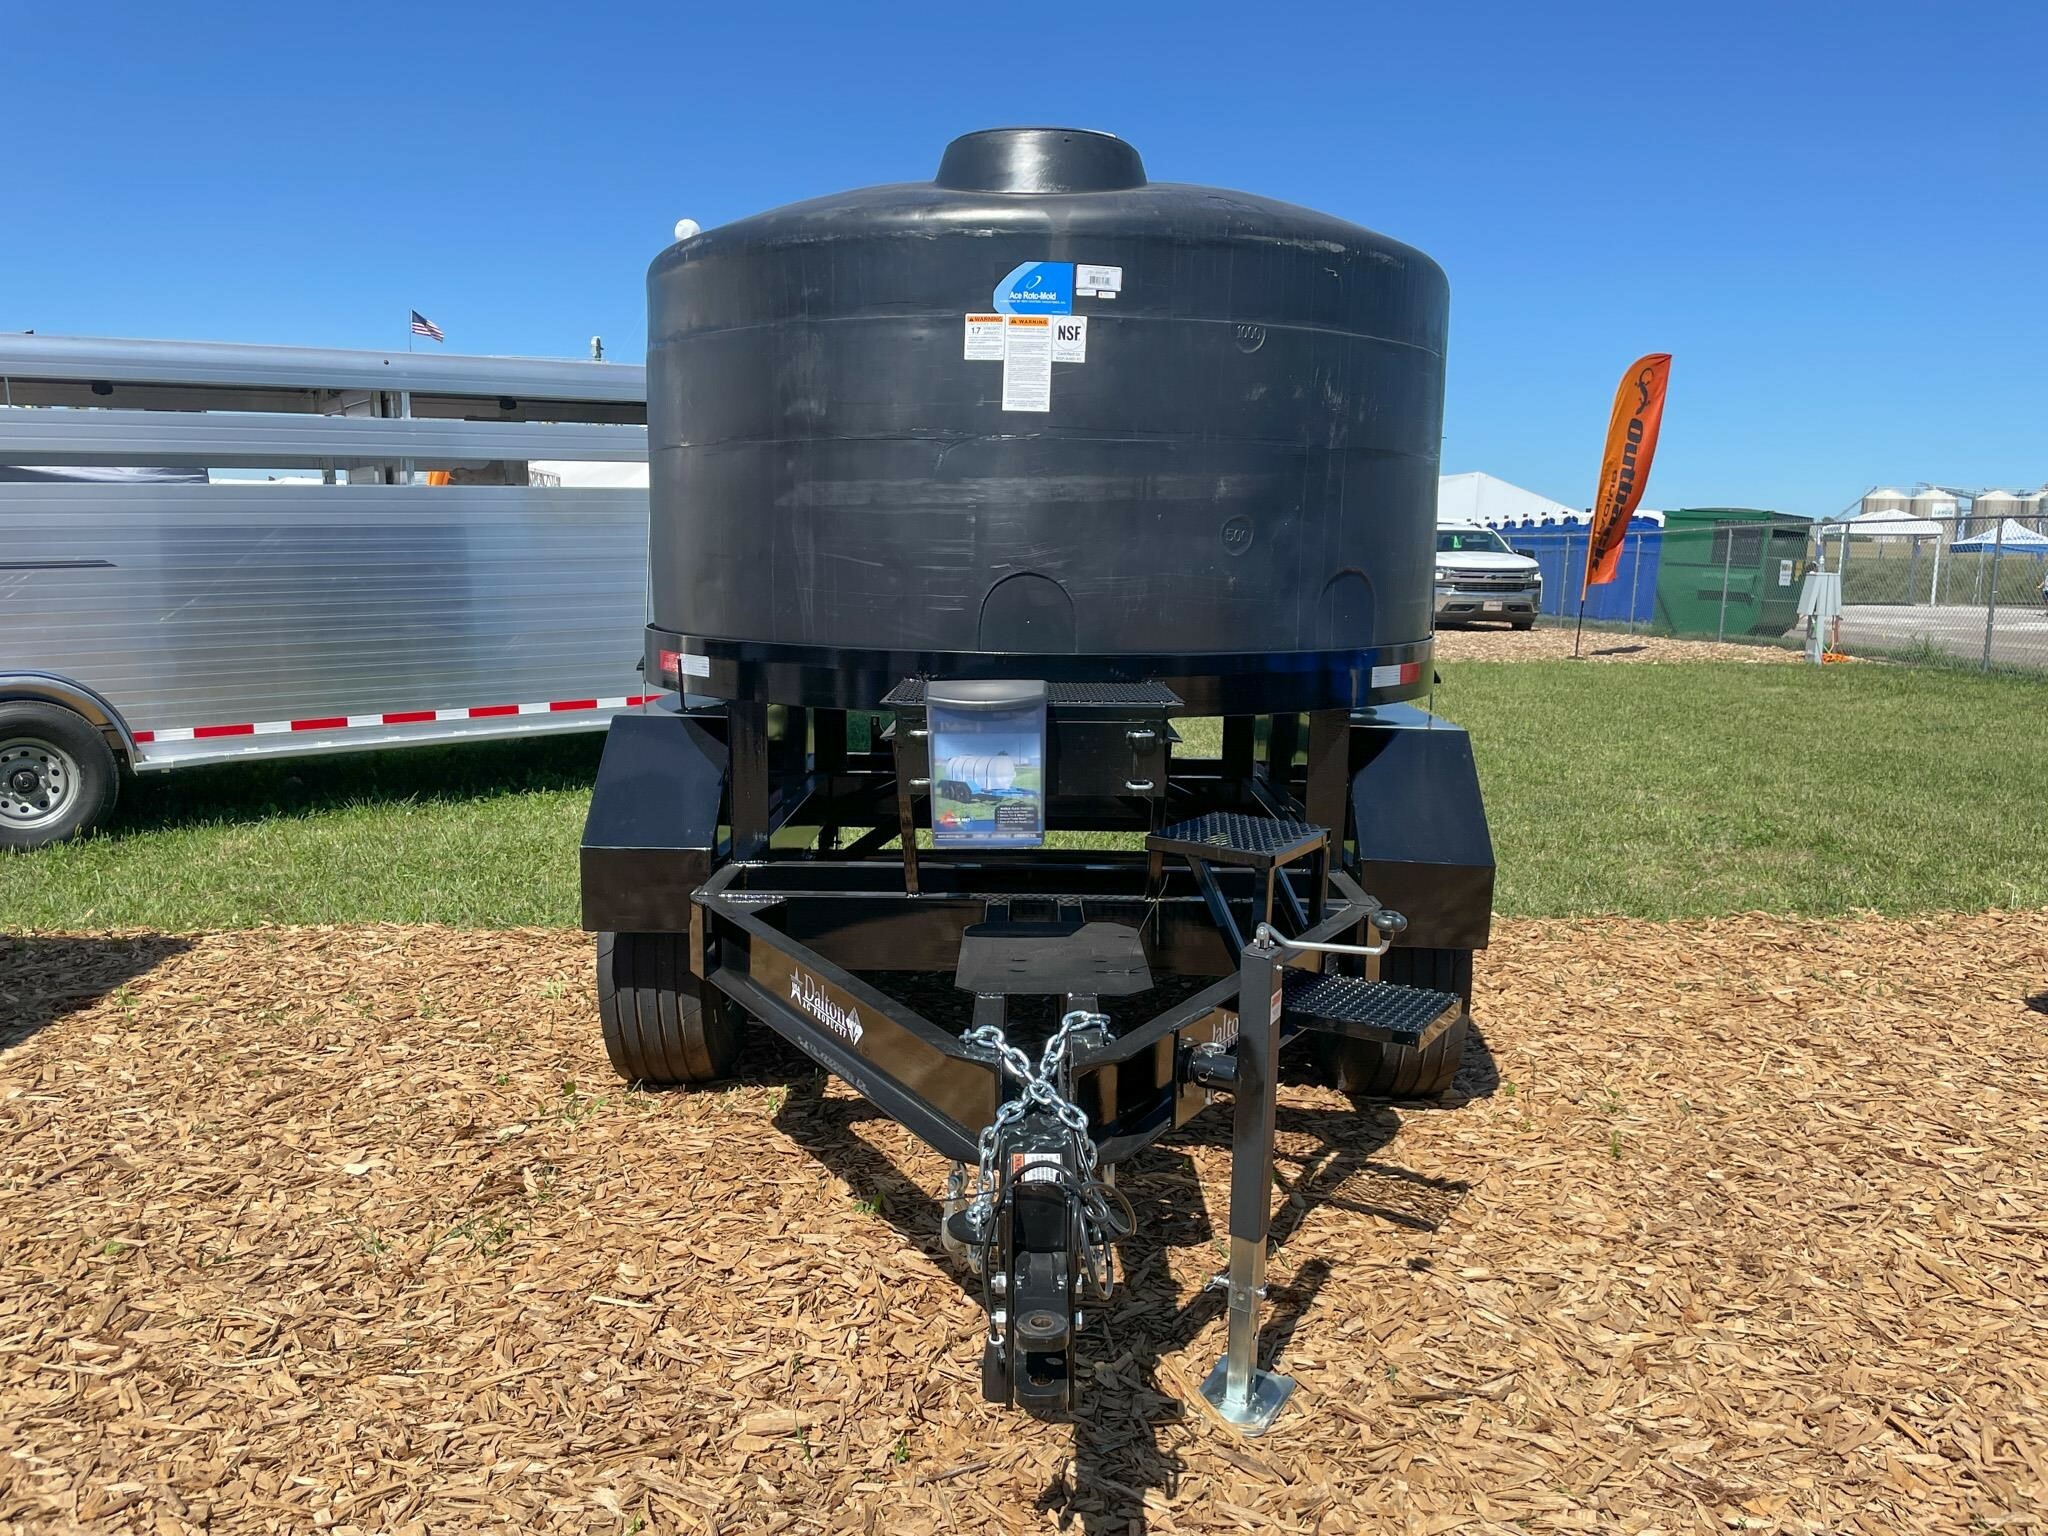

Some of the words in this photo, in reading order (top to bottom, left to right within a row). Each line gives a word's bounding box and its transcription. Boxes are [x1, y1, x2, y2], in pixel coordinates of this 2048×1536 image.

[1009, 291, 1022, 300] Ace
[1023, 291, 1057, 300] Roto-Mold
[1058, 325, 1081, 341] NSF
[802, 1000, 811, 1011] AG
[804, 973, 847, 1028] Dalton
